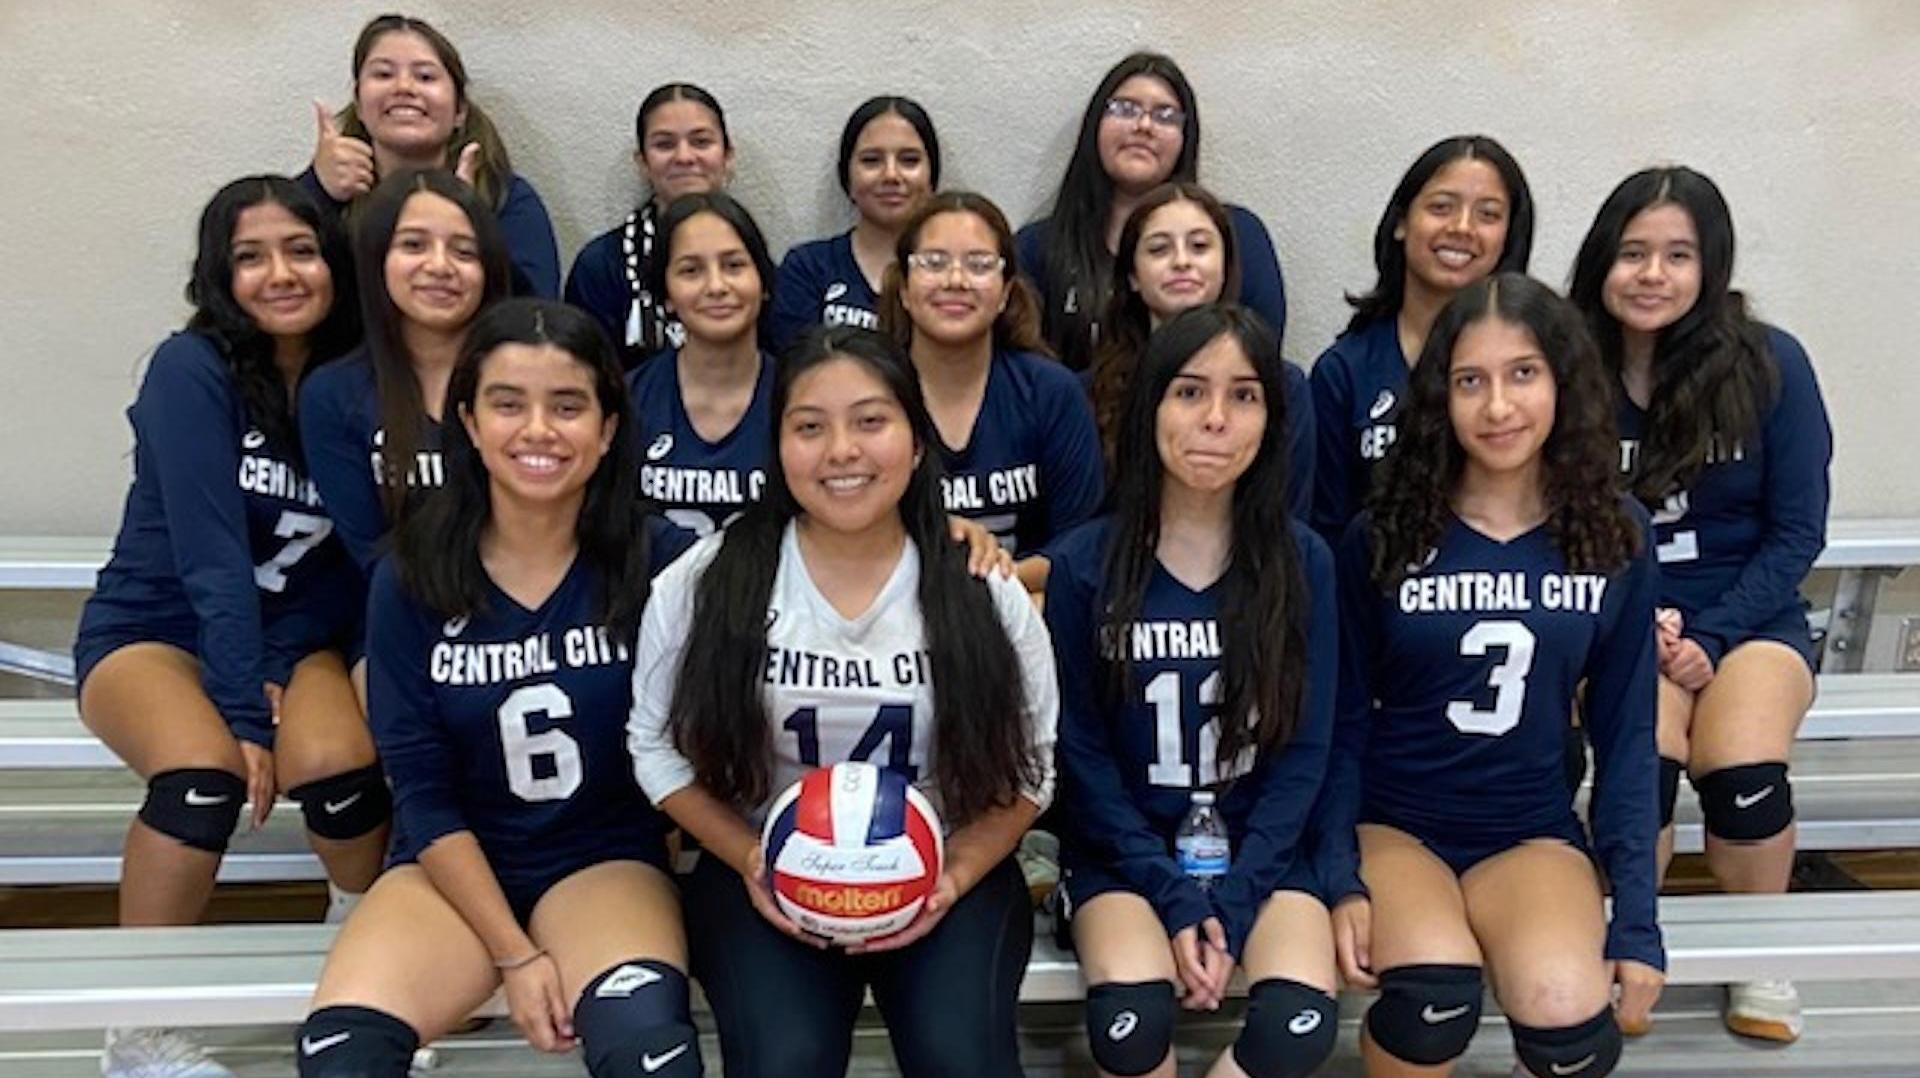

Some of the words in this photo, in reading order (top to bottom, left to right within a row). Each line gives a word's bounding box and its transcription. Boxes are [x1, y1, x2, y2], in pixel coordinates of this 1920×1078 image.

[640, 464, 743, 502] CENTRAL
[989, 463, 1037, 505] CITY
[253, 510, 334, 592] 7
[1400, 572, 1532, 613] CENTRAL
[1541, 573, 1607, 614] CITY
[431, 633, 557, 685] CENTRAL
[763, 648, 880, 687] ENTRAL
[1446, 620, 1536, 736] 3
[499, 682, 583, 802] 6
[784, 704, 918, 780] 14
[798, 884, 904, 912] molten
